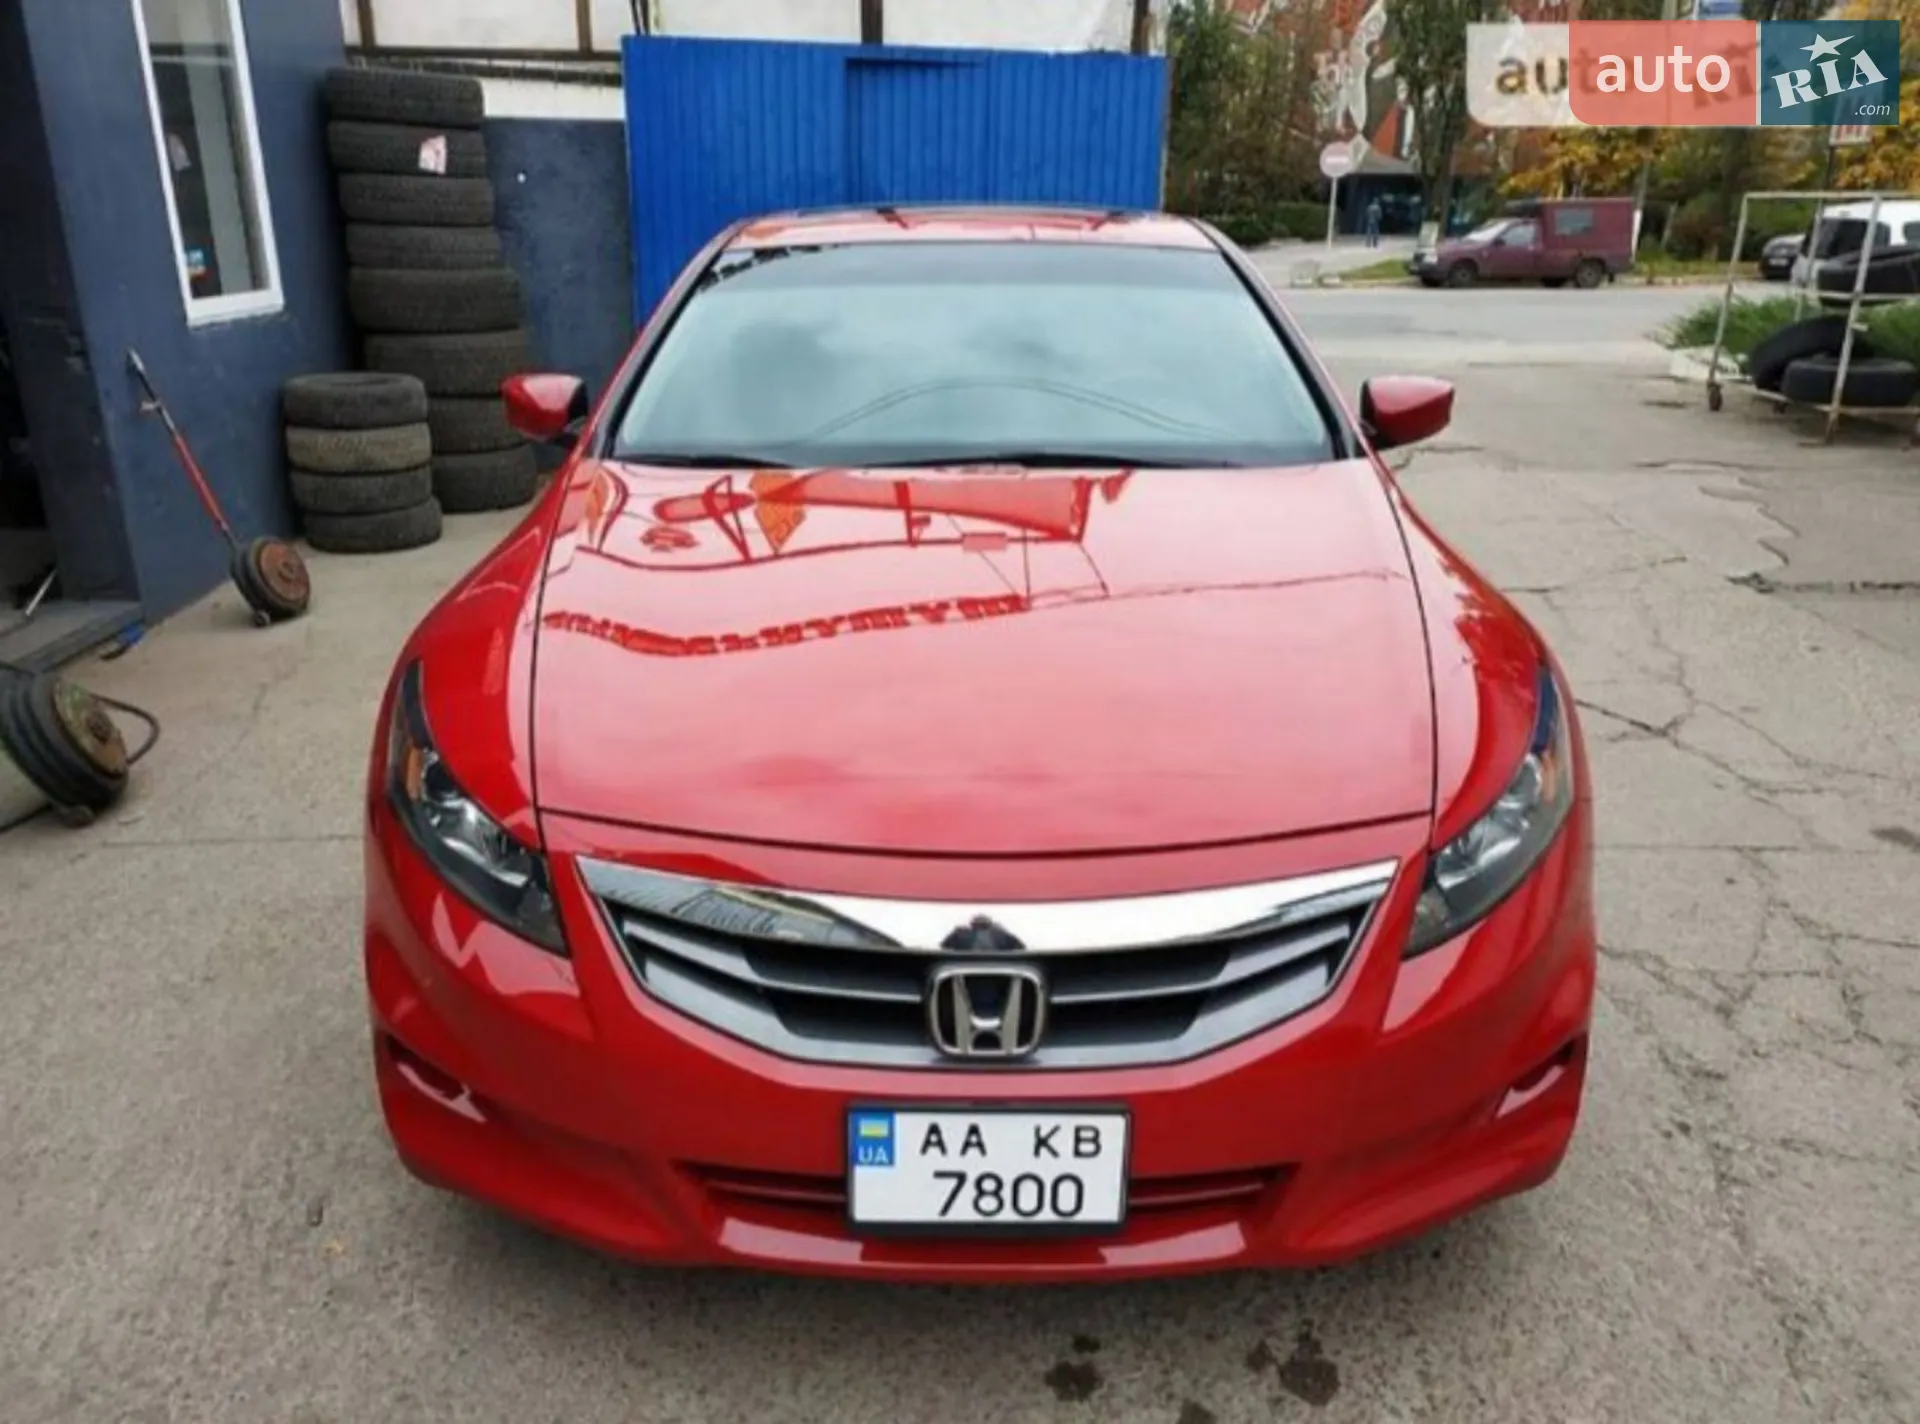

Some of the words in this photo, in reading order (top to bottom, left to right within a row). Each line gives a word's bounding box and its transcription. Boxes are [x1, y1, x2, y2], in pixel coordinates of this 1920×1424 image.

[858, 1147, 889, 1164] UA
[919, 1122, 988, 1157] AA
[1032, 1124, 1102, 1159] KB
[932, 1170, 1085, 1218] 7800
